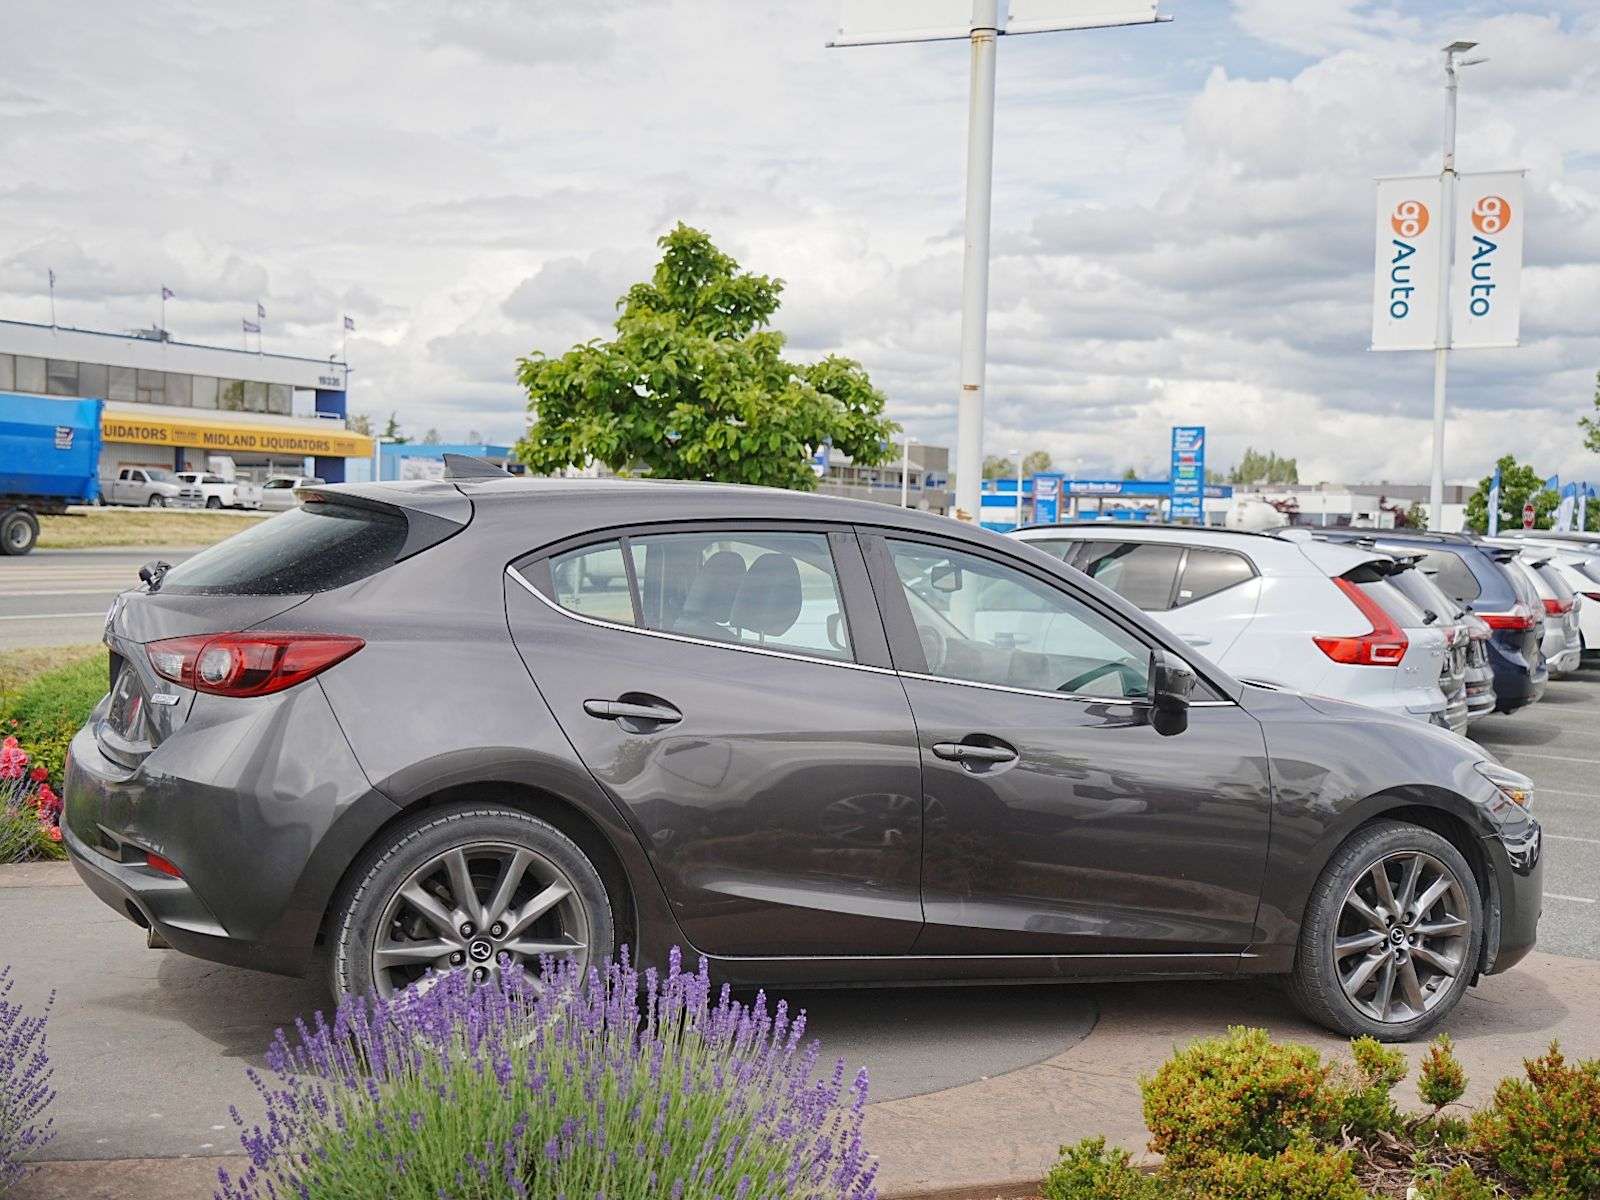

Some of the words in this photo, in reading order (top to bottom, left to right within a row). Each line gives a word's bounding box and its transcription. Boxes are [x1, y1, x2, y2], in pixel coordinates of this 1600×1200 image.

[1394, 200, 1424, 238] go
[1473, 196, 1504, 234] go
[1390, 239, 1417, 319] Auto
[1470, 235, 1498, 317] Auto
[103, 425, 168, 441] UIDATORS
[203, 432, 256, 447] MIDLAND
[261, 438, 331, 452] LIQUIDATORS
